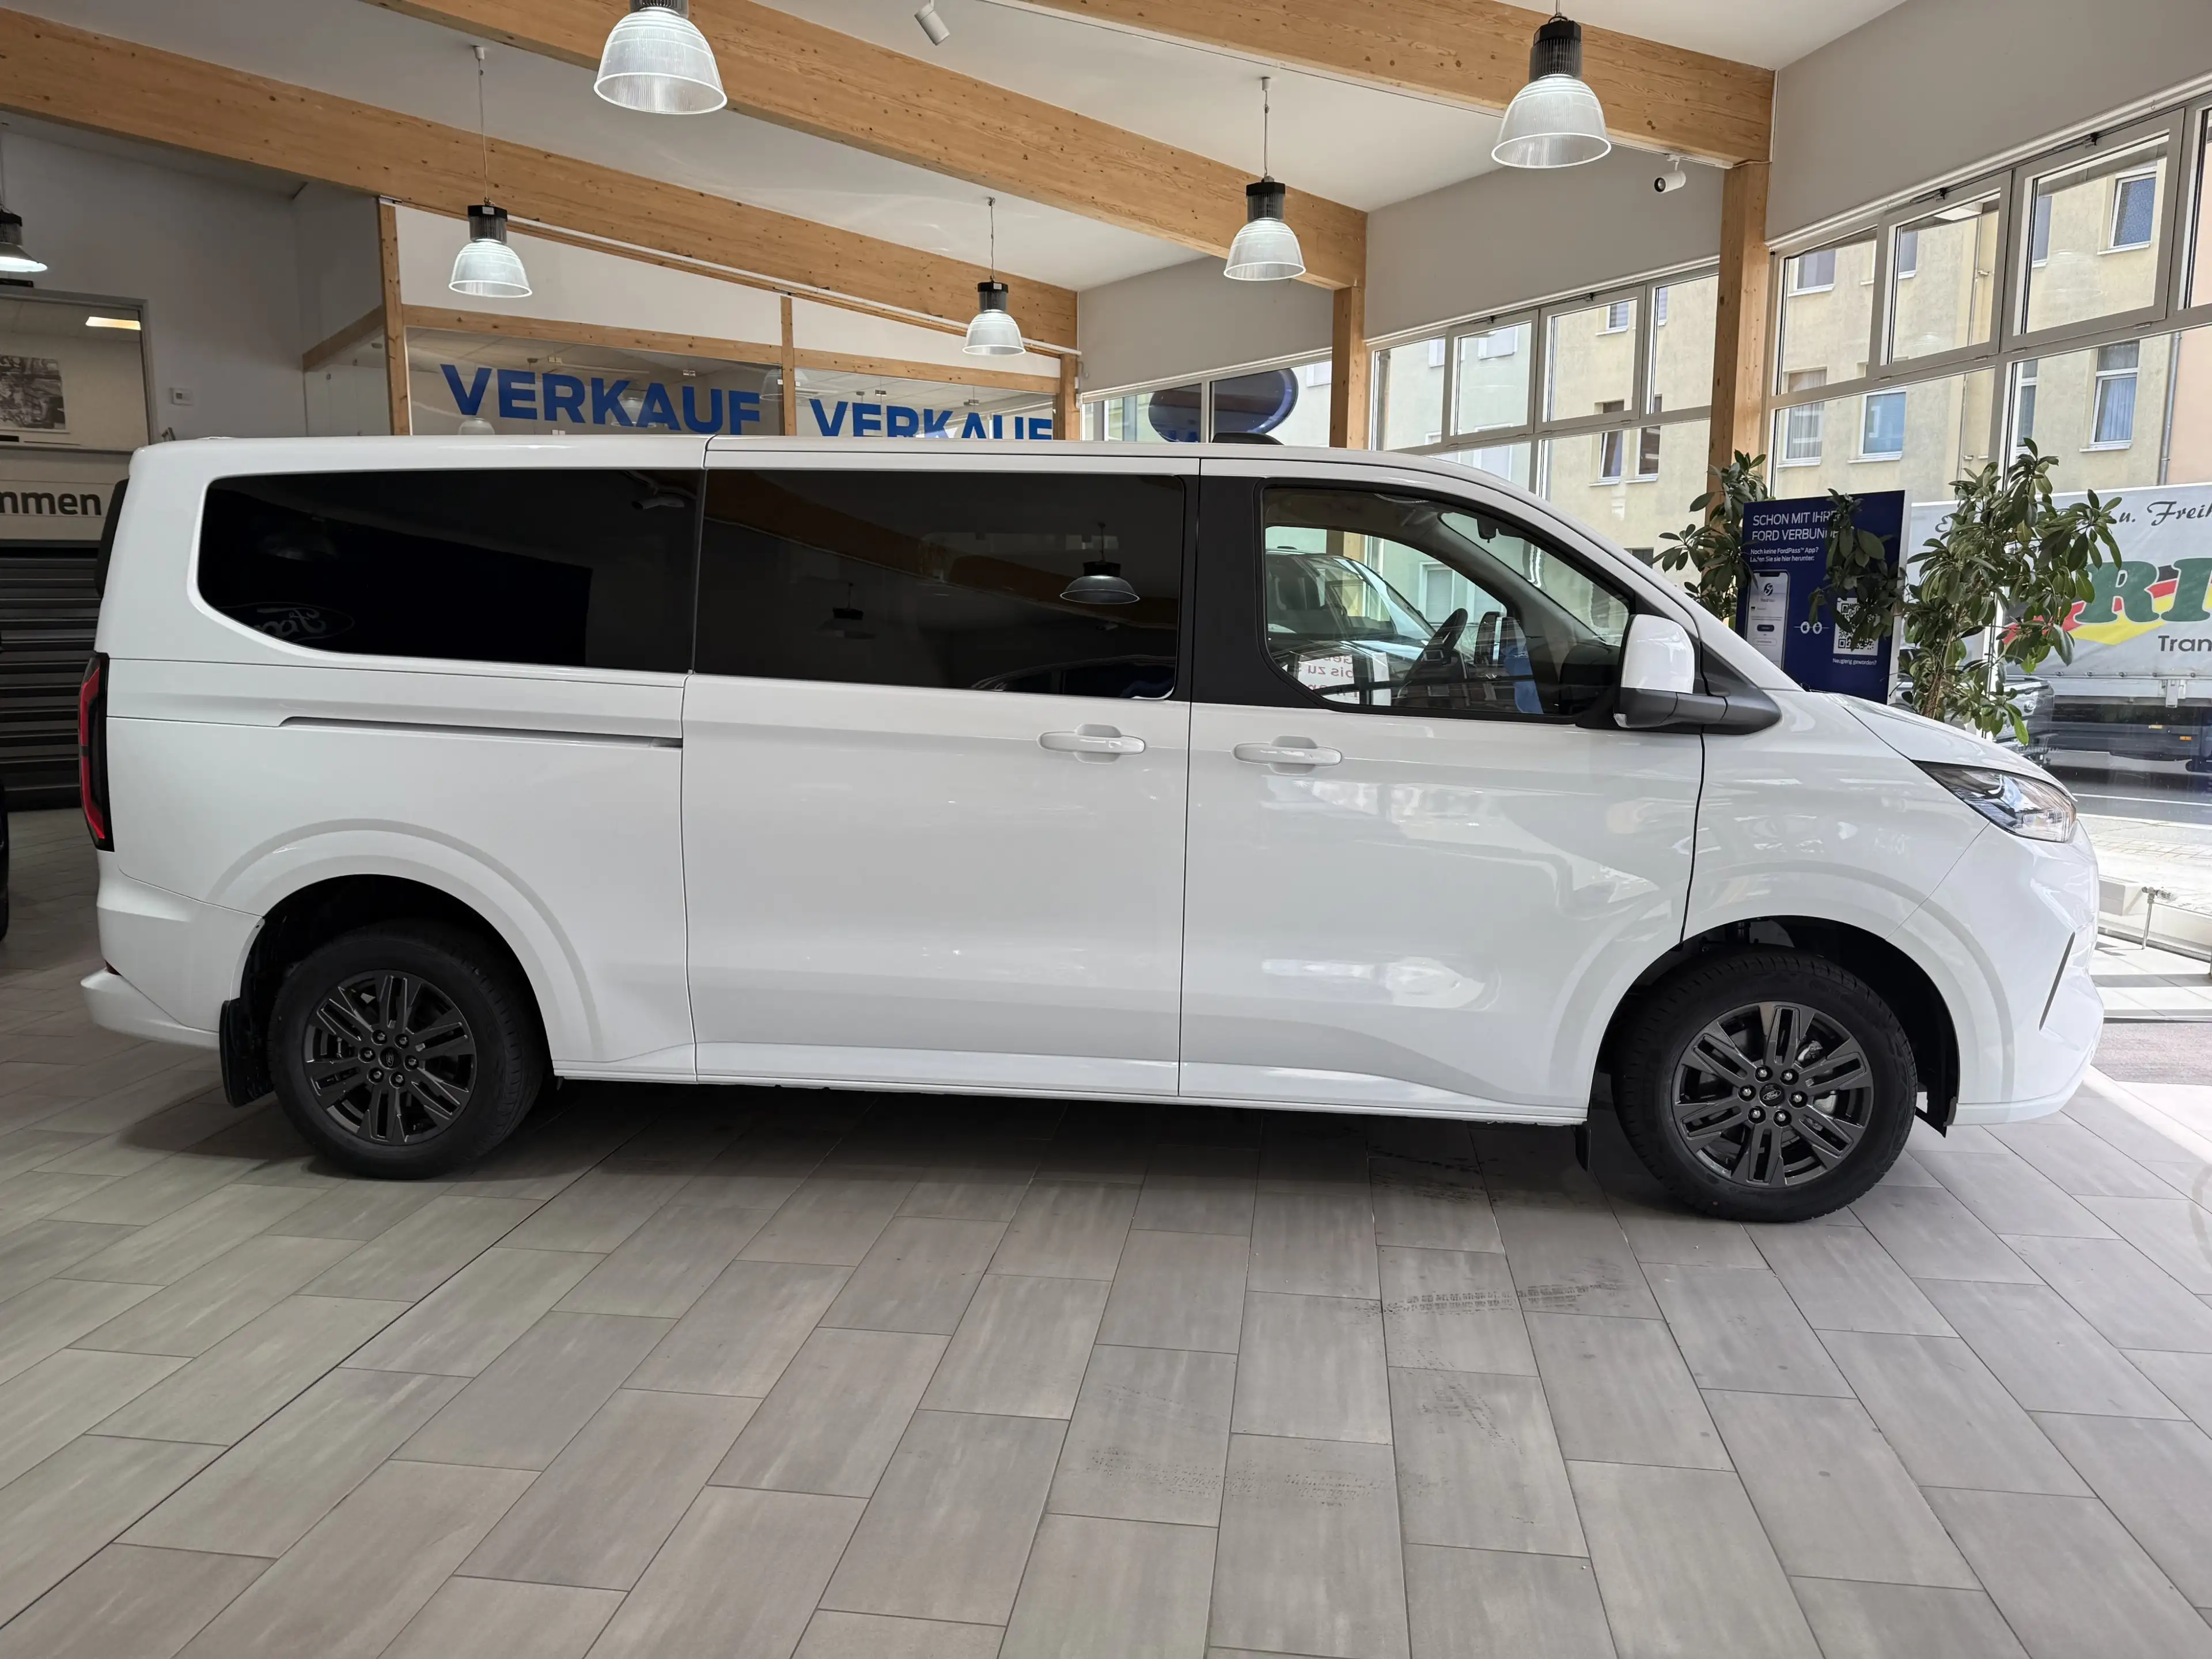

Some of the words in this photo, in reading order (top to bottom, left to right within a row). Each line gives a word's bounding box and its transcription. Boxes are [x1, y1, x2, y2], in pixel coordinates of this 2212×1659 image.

[440, 364, 760, 434] VERKAUF
[1753, 513, 1789, 526] SCHON
[1791, 512, 1810, 524] MIT
[1812, 510, 1841, 523] IHRE
[1752, 530, 1779, 541] FORD
